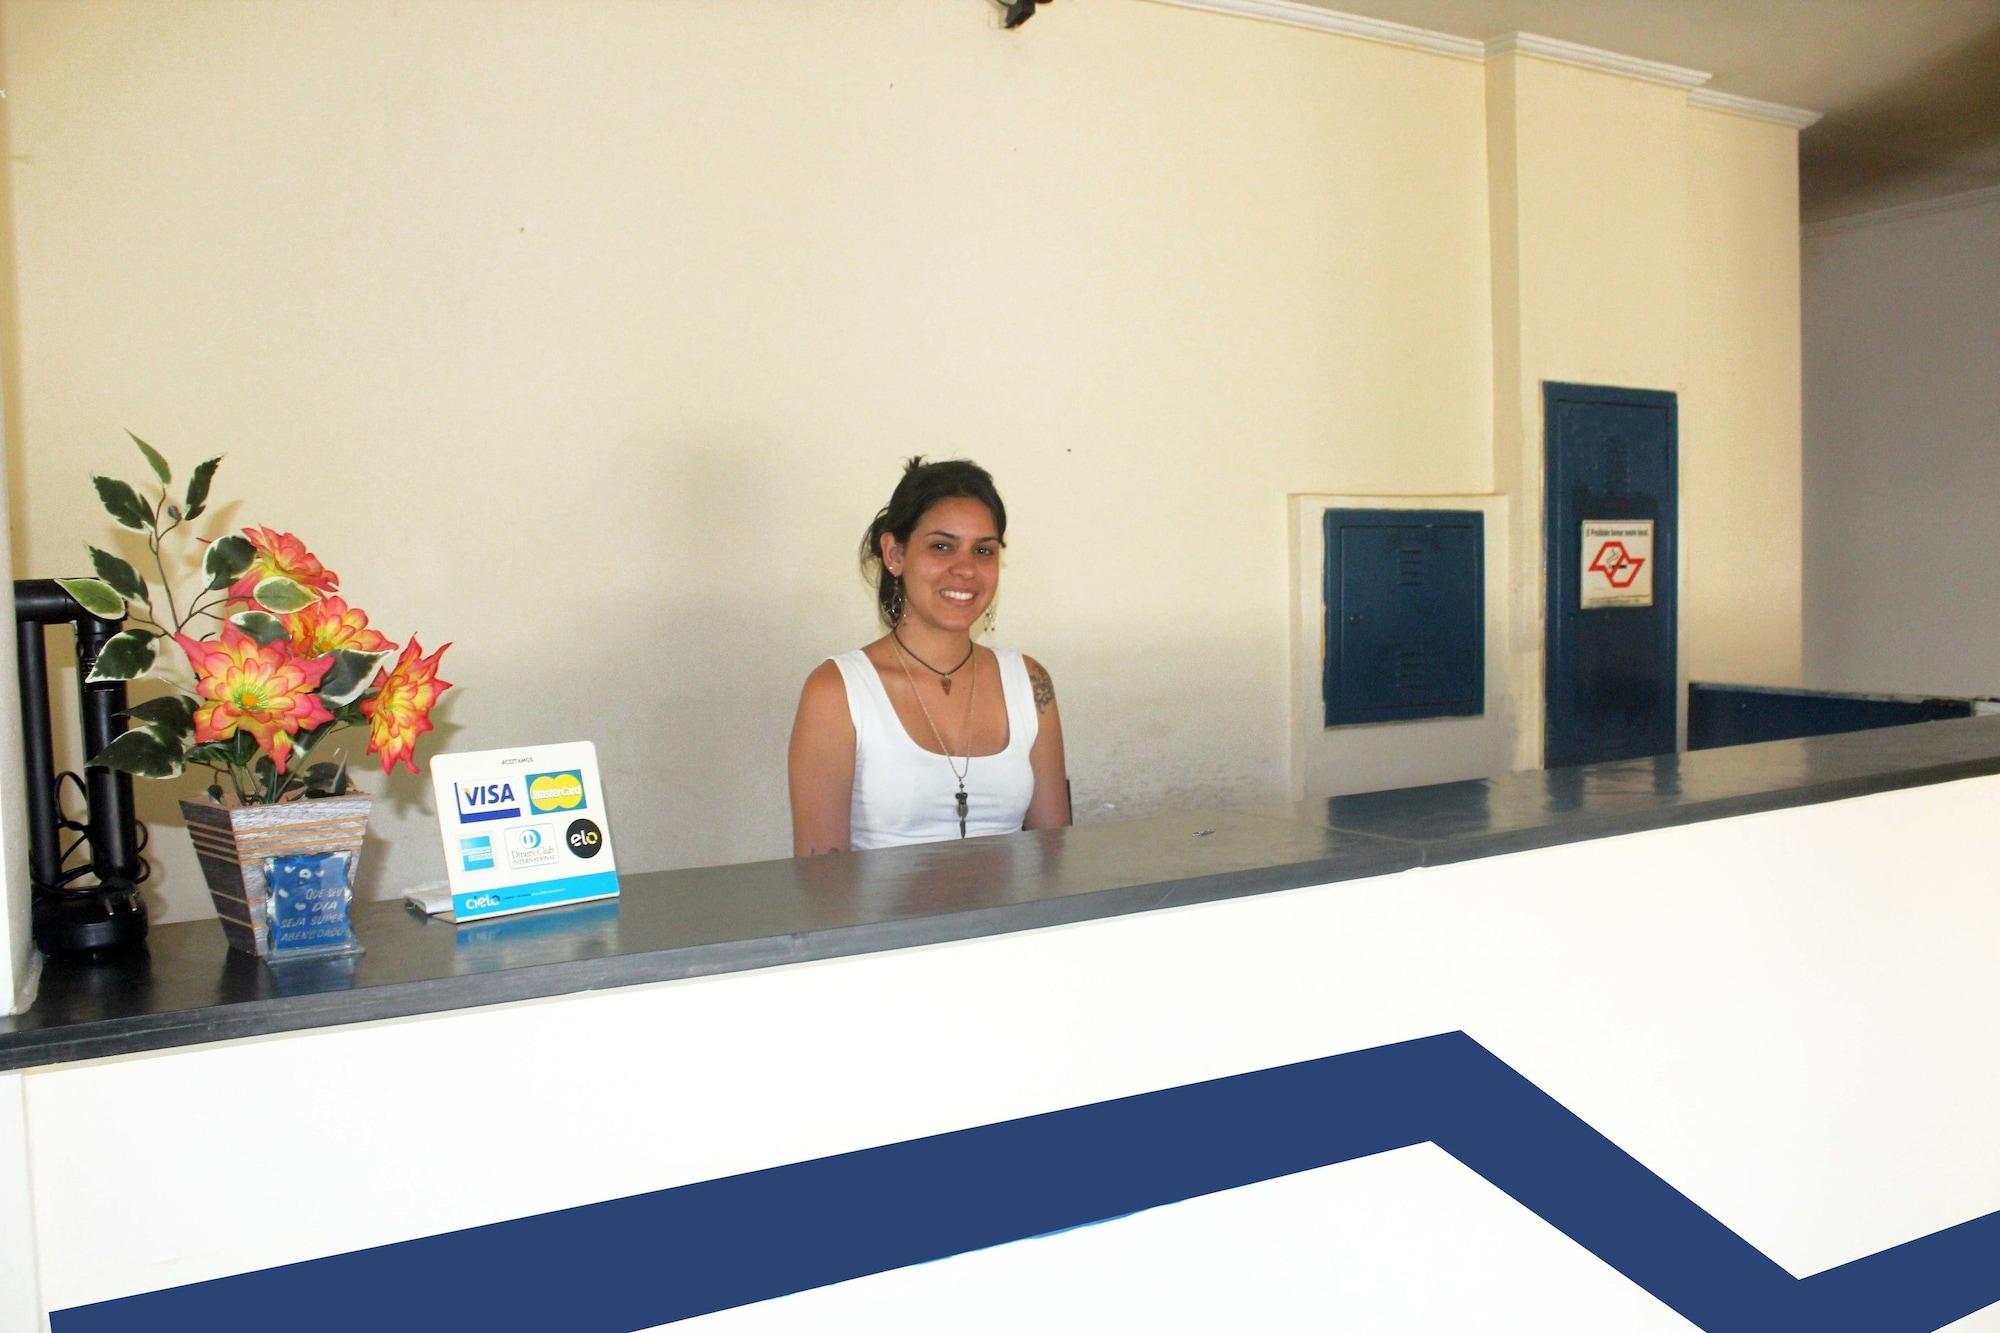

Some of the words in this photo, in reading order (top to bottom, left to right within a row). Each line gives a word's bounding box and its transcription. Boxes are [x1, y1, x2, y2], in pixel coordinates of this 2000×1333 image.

[464, 783, 515, 806] VISA
[531, 786, 580, 800] MasterCard
[570, 830, 598, 847] elo
[312, 902, 337, 912] DIA
[465, 894, 500, 910] cielo
[280, 917, 305, 929] SEJA
